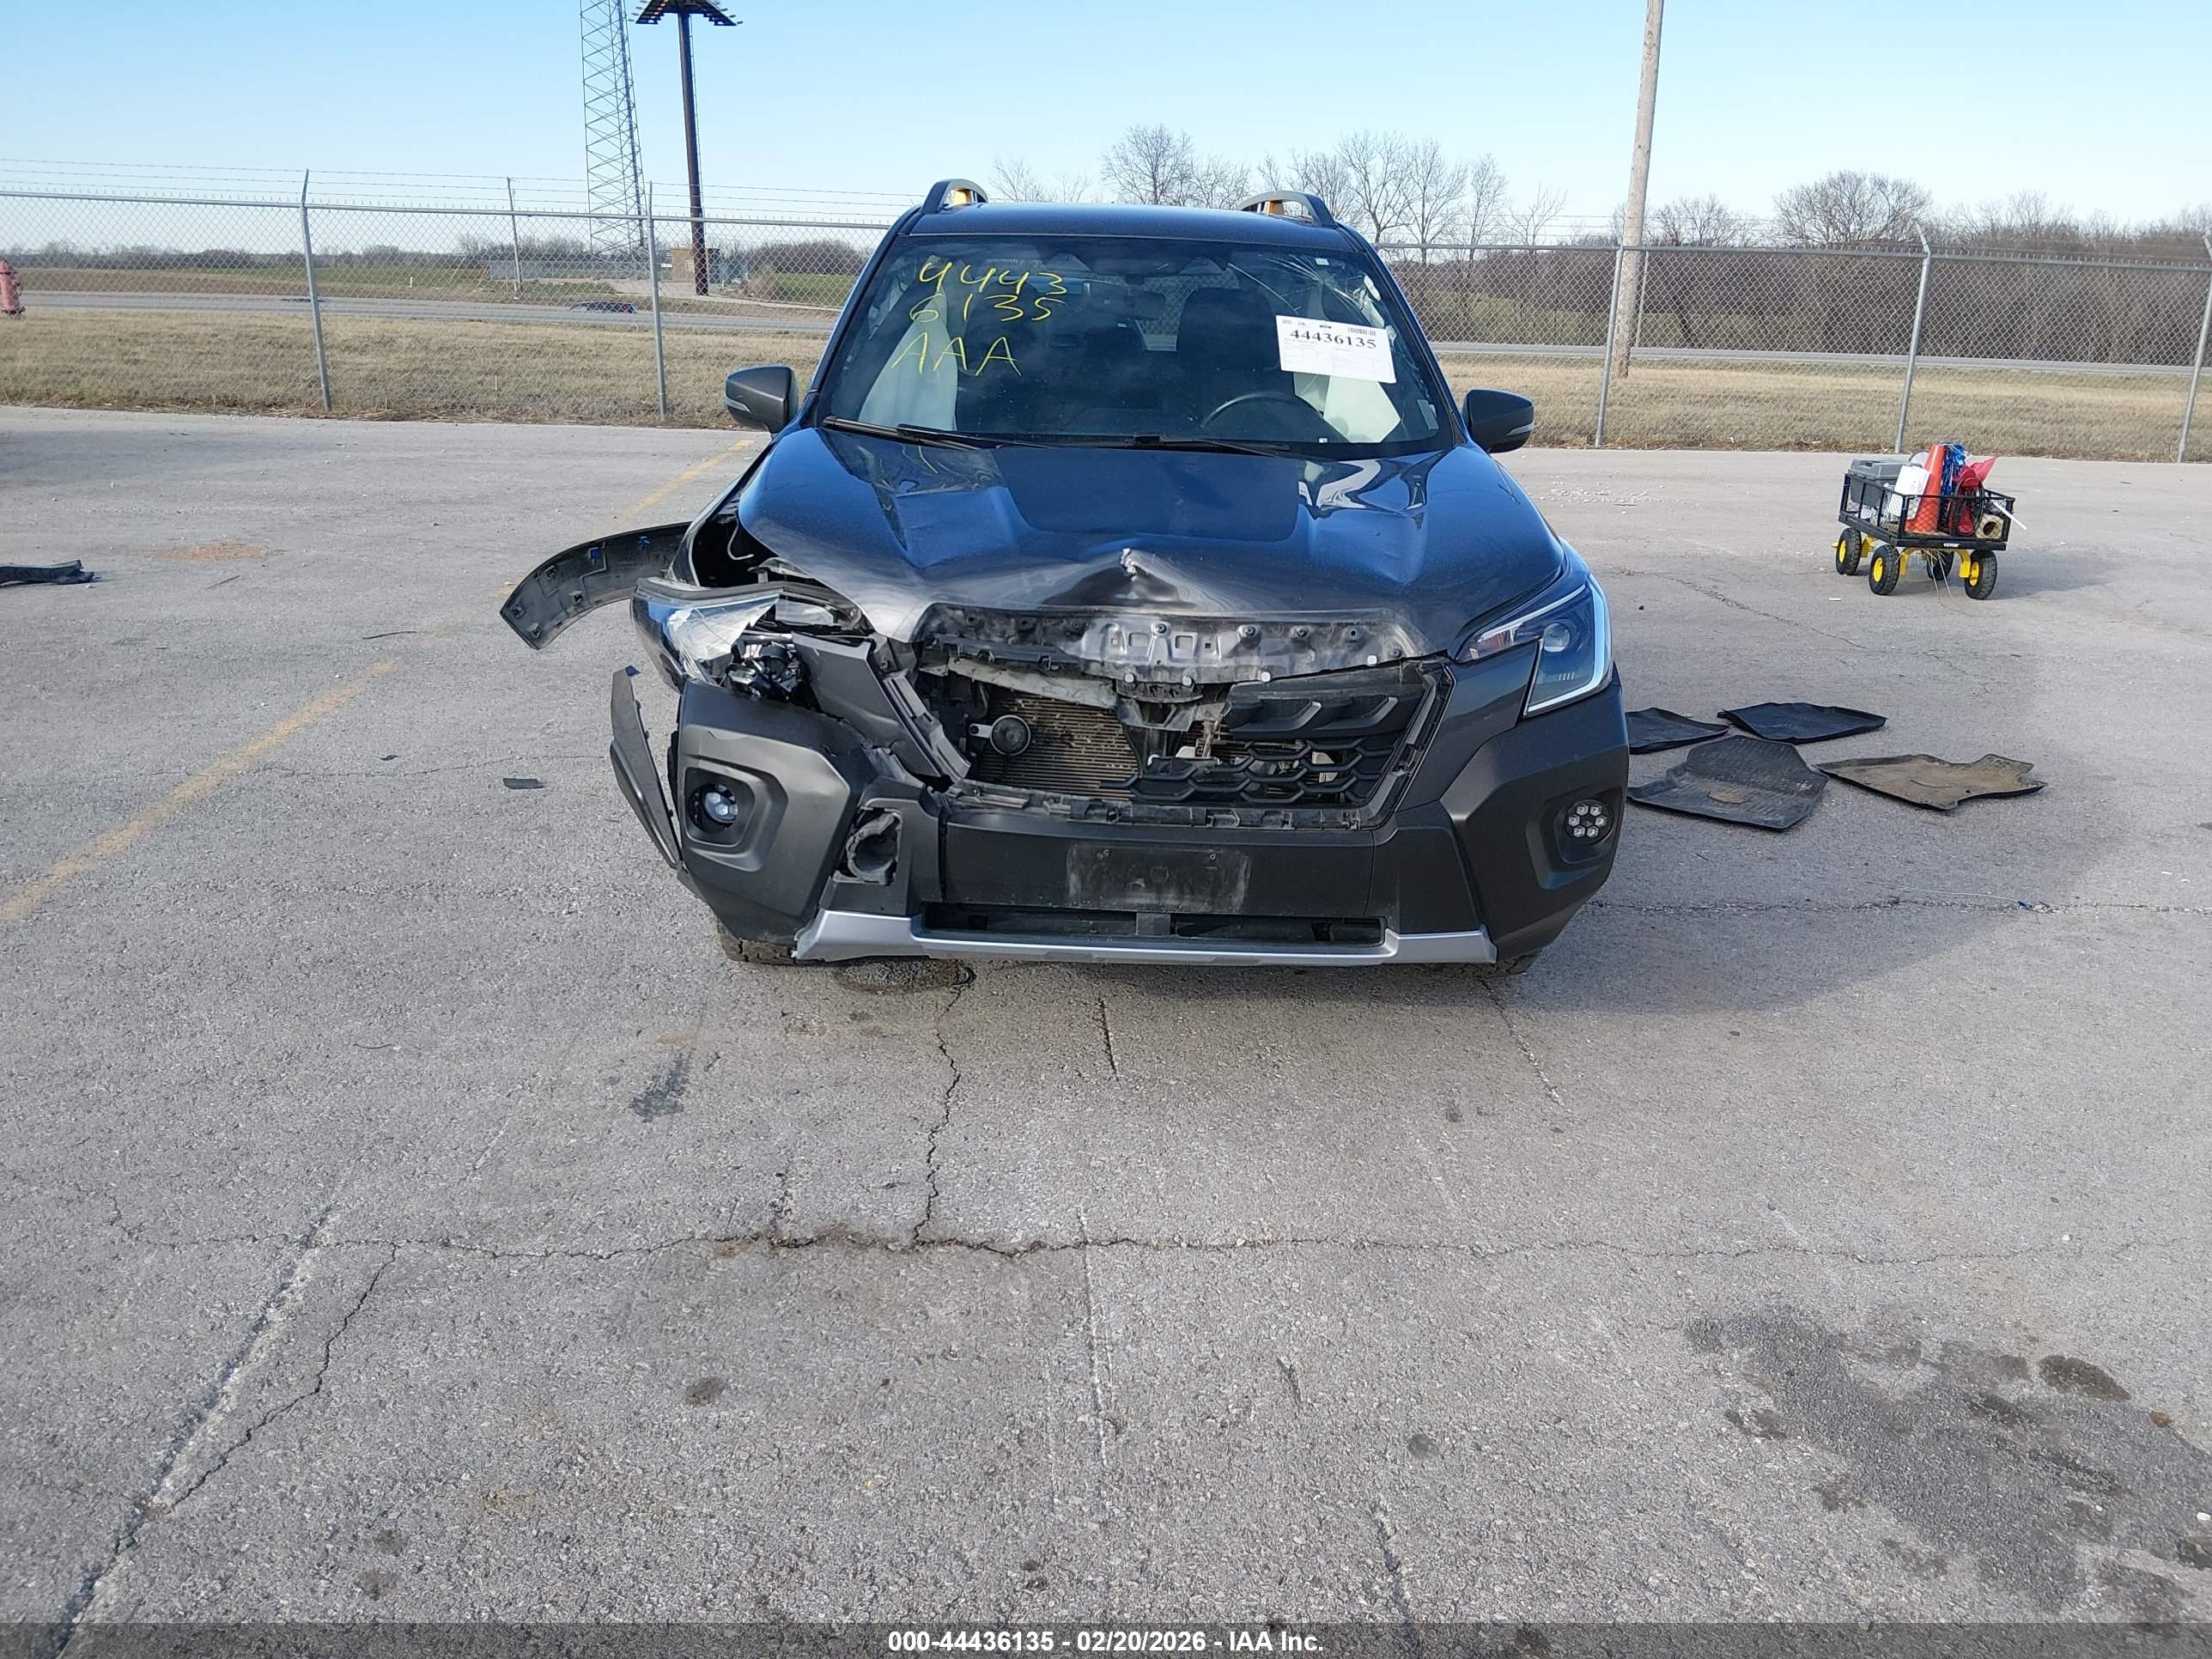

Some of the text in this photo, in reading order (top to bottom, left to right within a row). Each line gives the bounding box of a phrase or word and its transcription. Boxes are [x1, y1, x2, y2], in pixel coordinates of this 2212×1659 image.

[909, 293, 1066, 323] 6135
[890, 331, 1023, 377] AAA
[1289, 329, 1377, 349] 44436135
